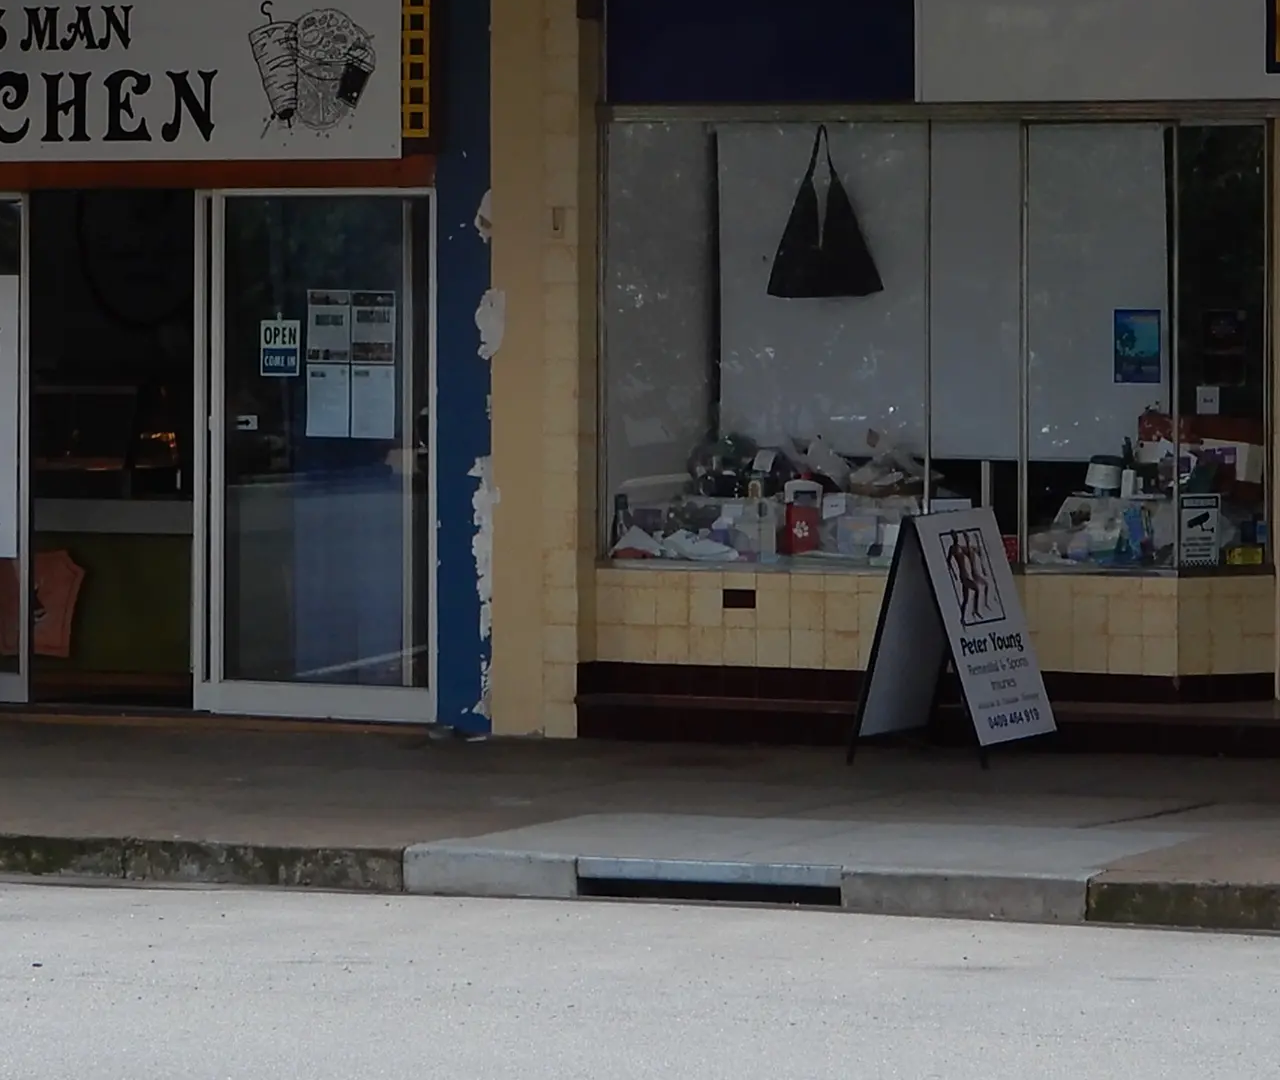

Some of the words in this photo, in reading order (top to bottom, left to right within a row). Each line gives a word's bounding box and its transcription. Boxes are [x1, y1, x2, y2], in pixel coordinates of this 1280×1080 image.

[20, 4, 134, 52] MAN
[264, 326, 297, 345] OPEN
[960, 636, 988, 657] Peter
[988, 631, 1024, 653] Young
